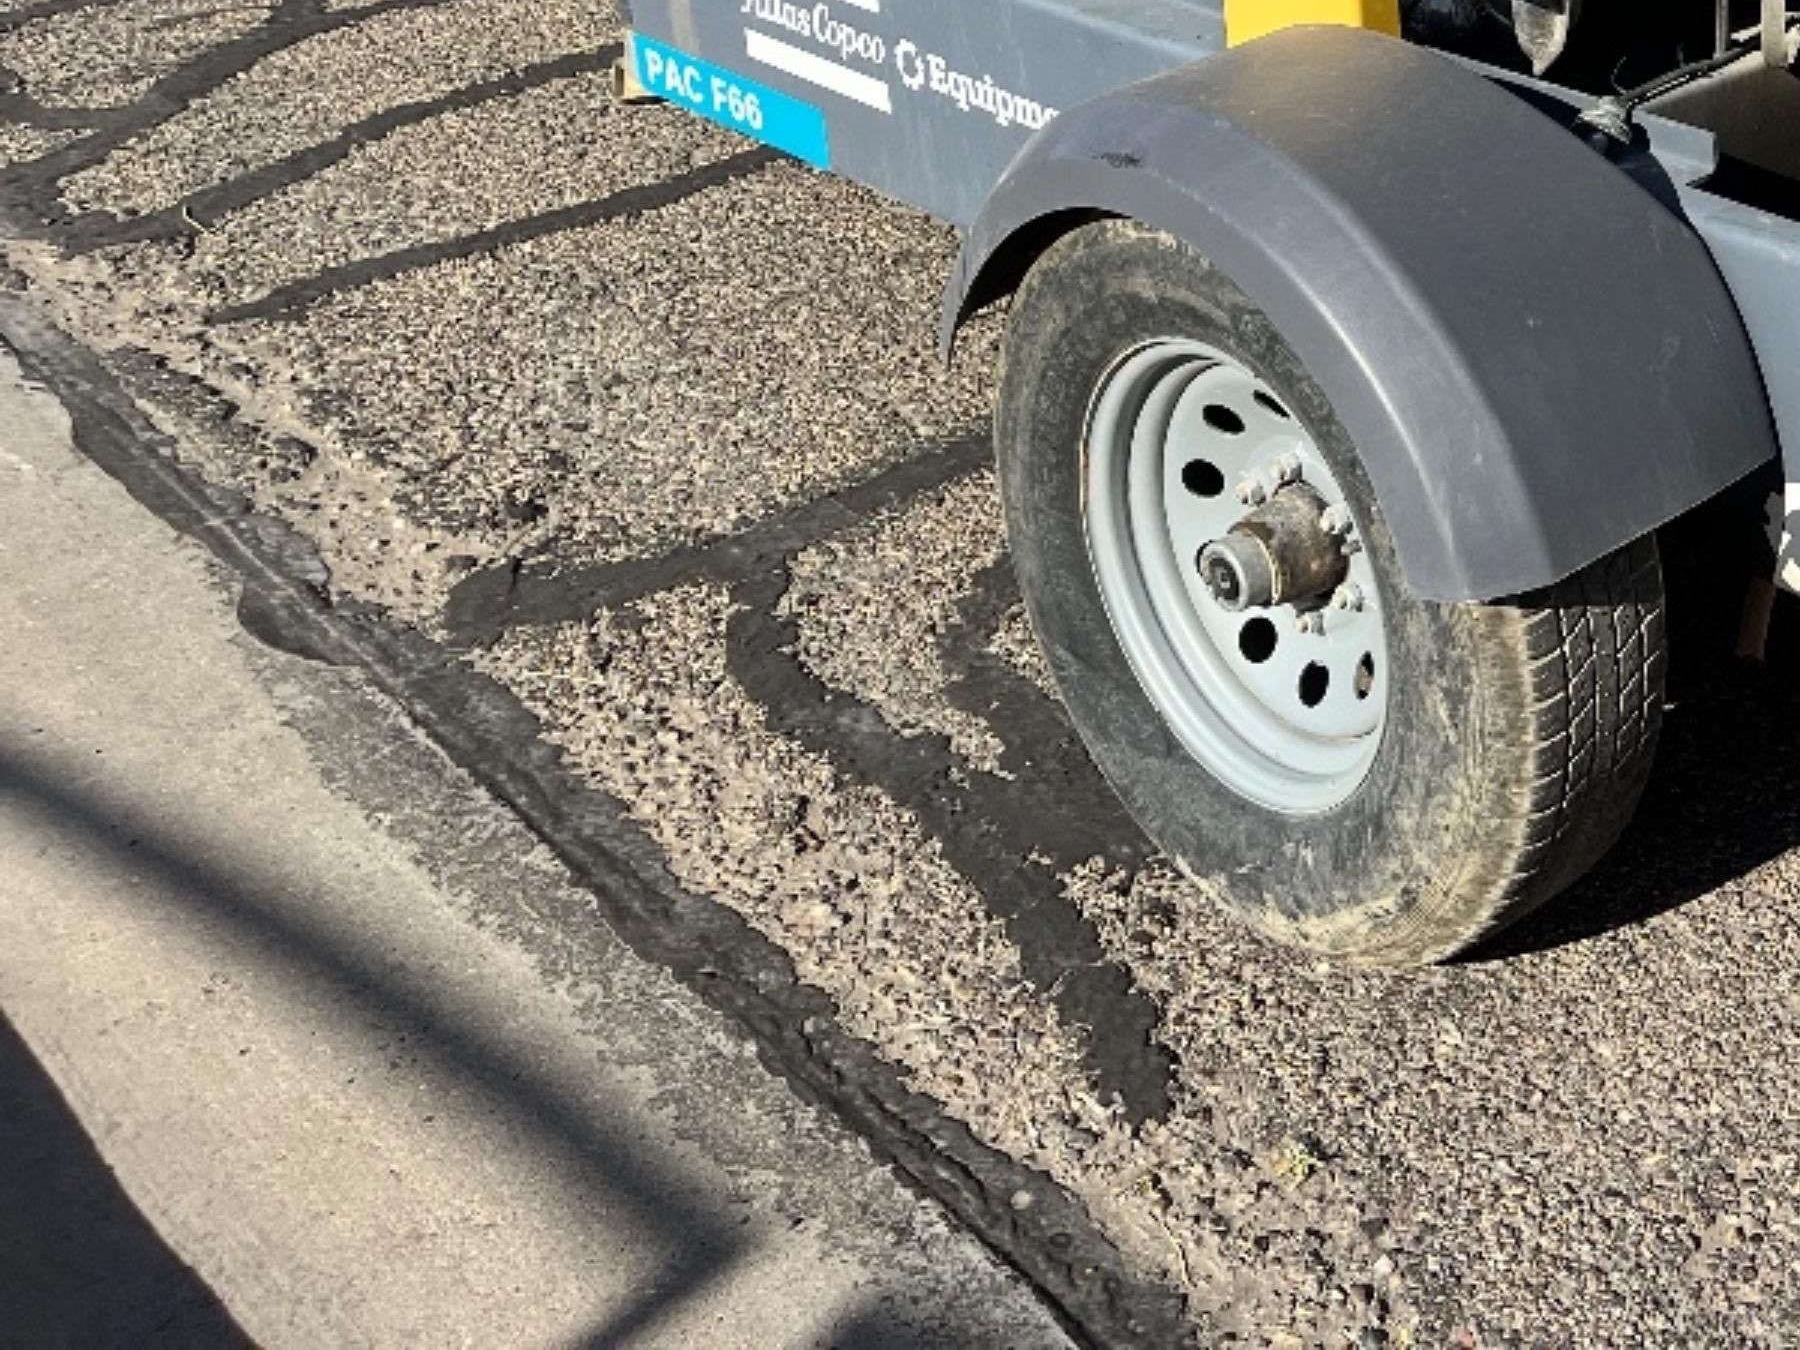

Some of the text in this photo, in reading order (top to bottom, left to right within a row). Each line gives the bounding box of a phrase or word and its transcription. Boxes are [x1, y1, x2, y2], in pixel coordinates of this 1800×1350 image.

[812, 1, 887, 65] Copco
[643, 47, 764, 131] PAC F66
